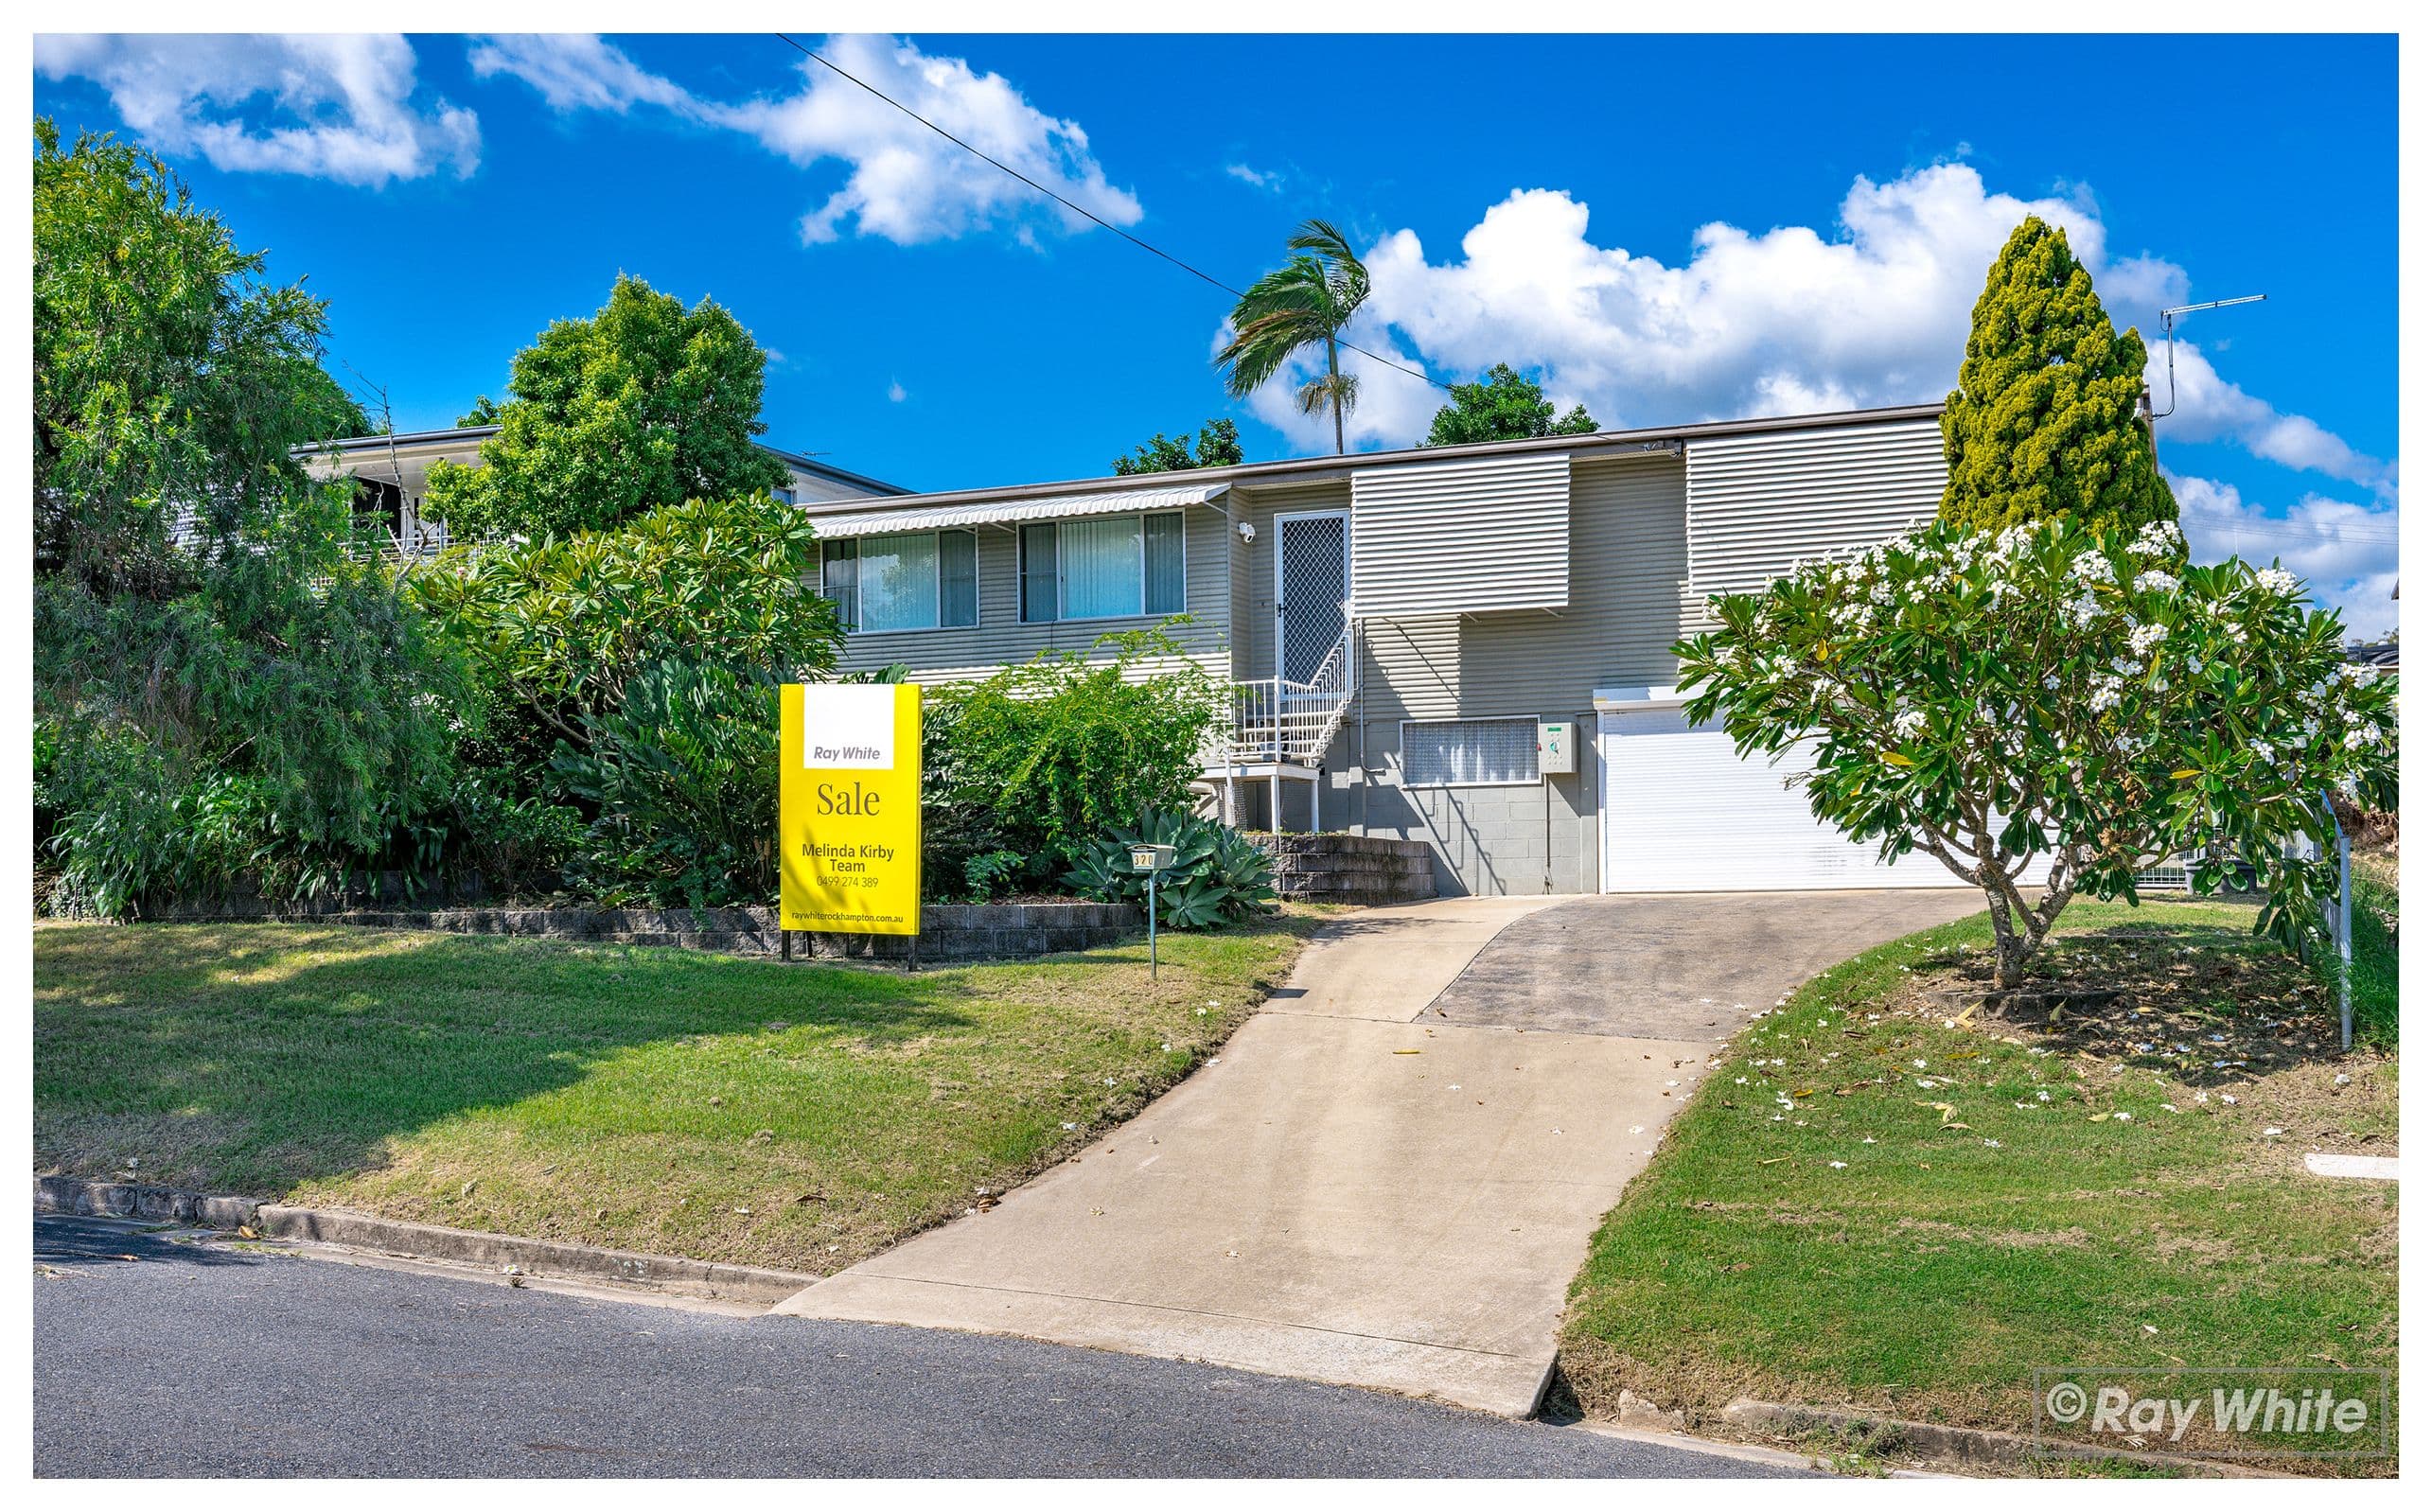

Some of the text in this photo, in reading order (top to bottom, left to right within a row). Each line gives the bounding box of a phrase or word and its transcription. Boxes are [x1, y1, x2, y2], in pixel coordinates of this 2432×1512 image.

[814, 746, 880, 761] Ray White
[817, 782, 880, 816] Sale
[802, 843, 894, 862] Melinda Kirby
[830, 858, 866, 872] Team
[1134, 854, 1154, 866] 320
[816, 875, 879, 888] 0499 274 389
[791, 910, 904, 923] raywhiterockhampton.com.au
